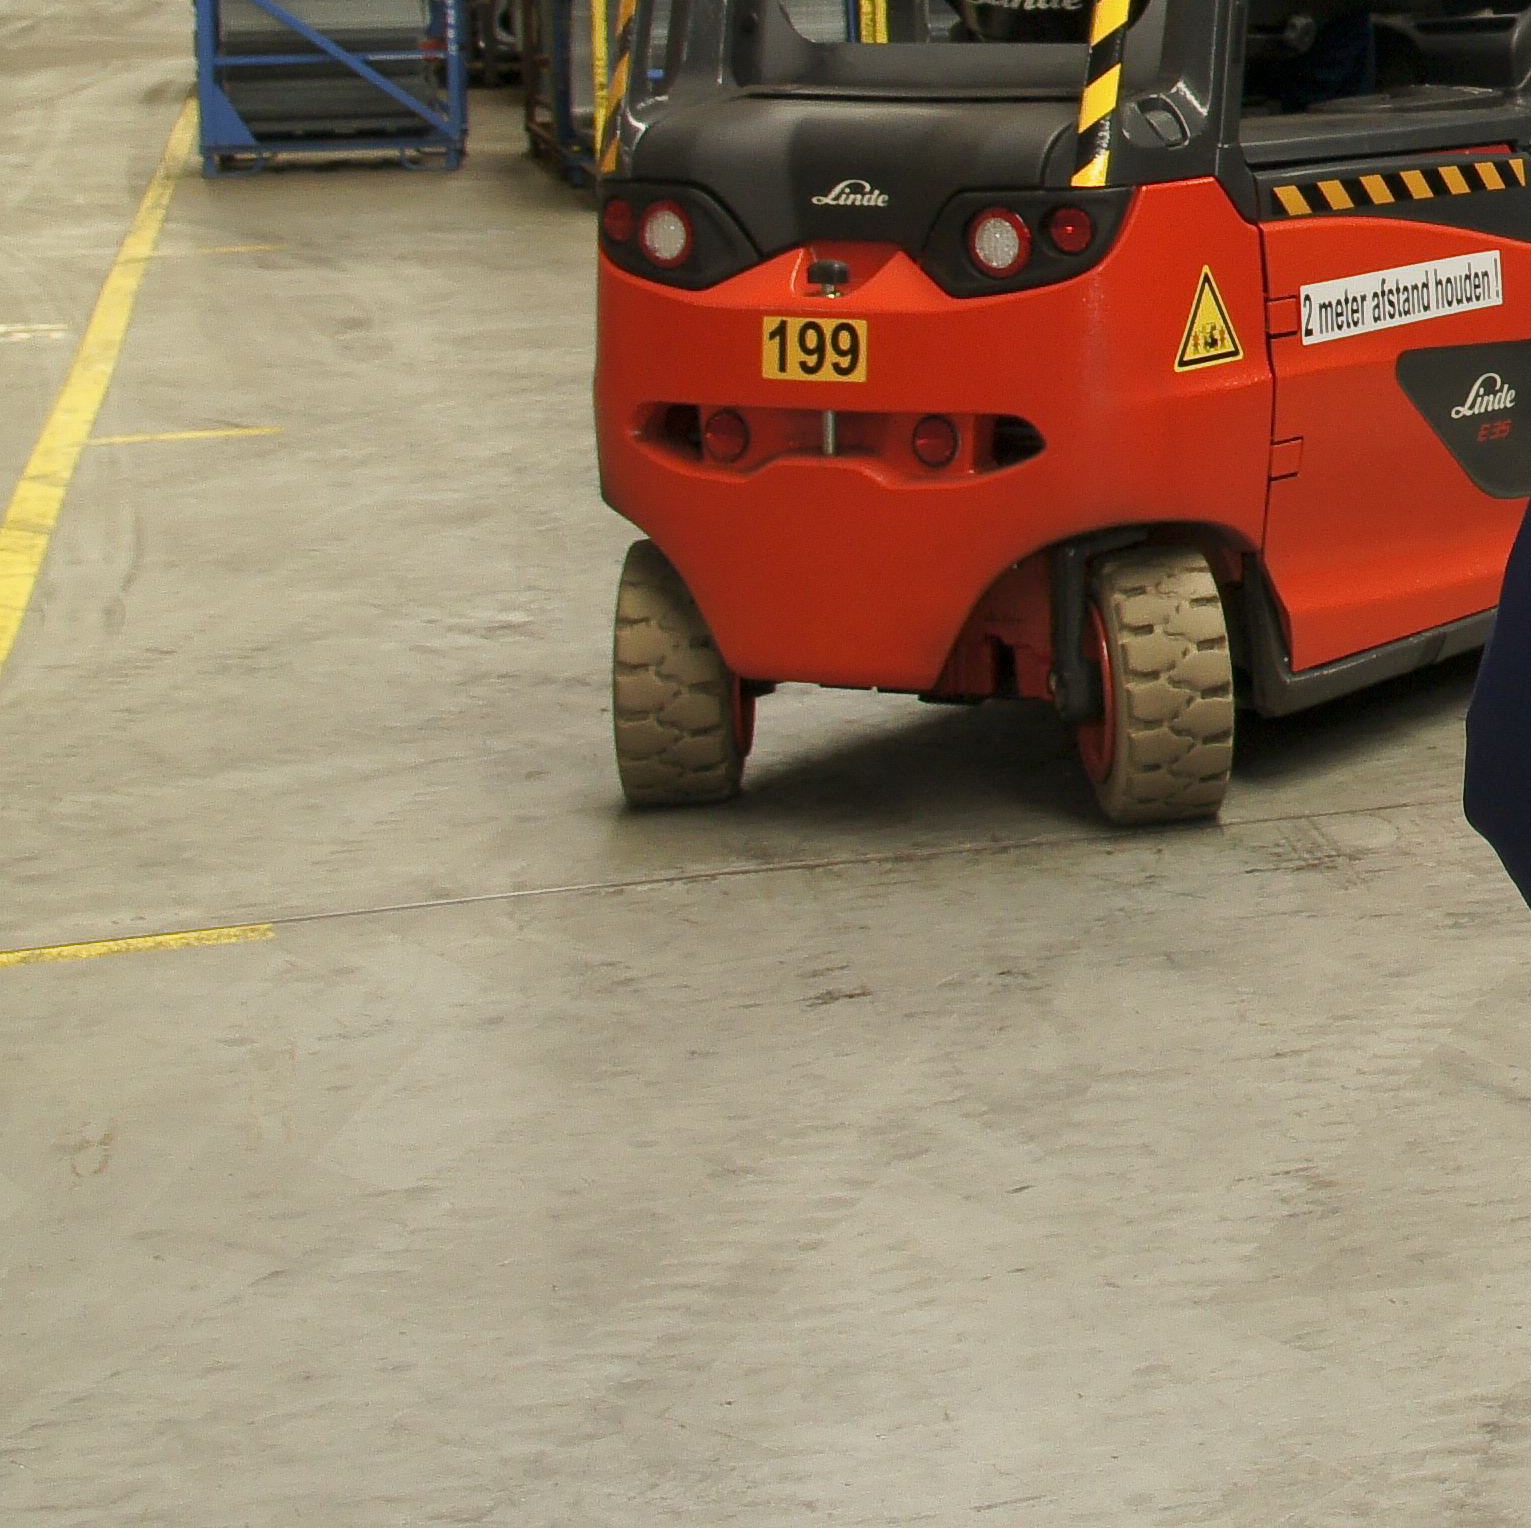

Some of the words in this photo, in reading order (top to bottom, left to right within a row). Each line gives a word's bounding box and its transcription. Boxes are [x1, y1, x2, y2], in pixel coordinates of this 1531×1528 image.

[811, 179, 889, 207] Linde
[1303, 293, 1314, 338] 2
[1318, 288, 1367, 335] meter
[1372, 270, 1431, 324] afstand
[1434, 262, 1491, 311] houden
[768, 319, 861, 377] 199
[1451, 372, 1516, 419] Linde
[1477, 419, 1513, 442] E35
